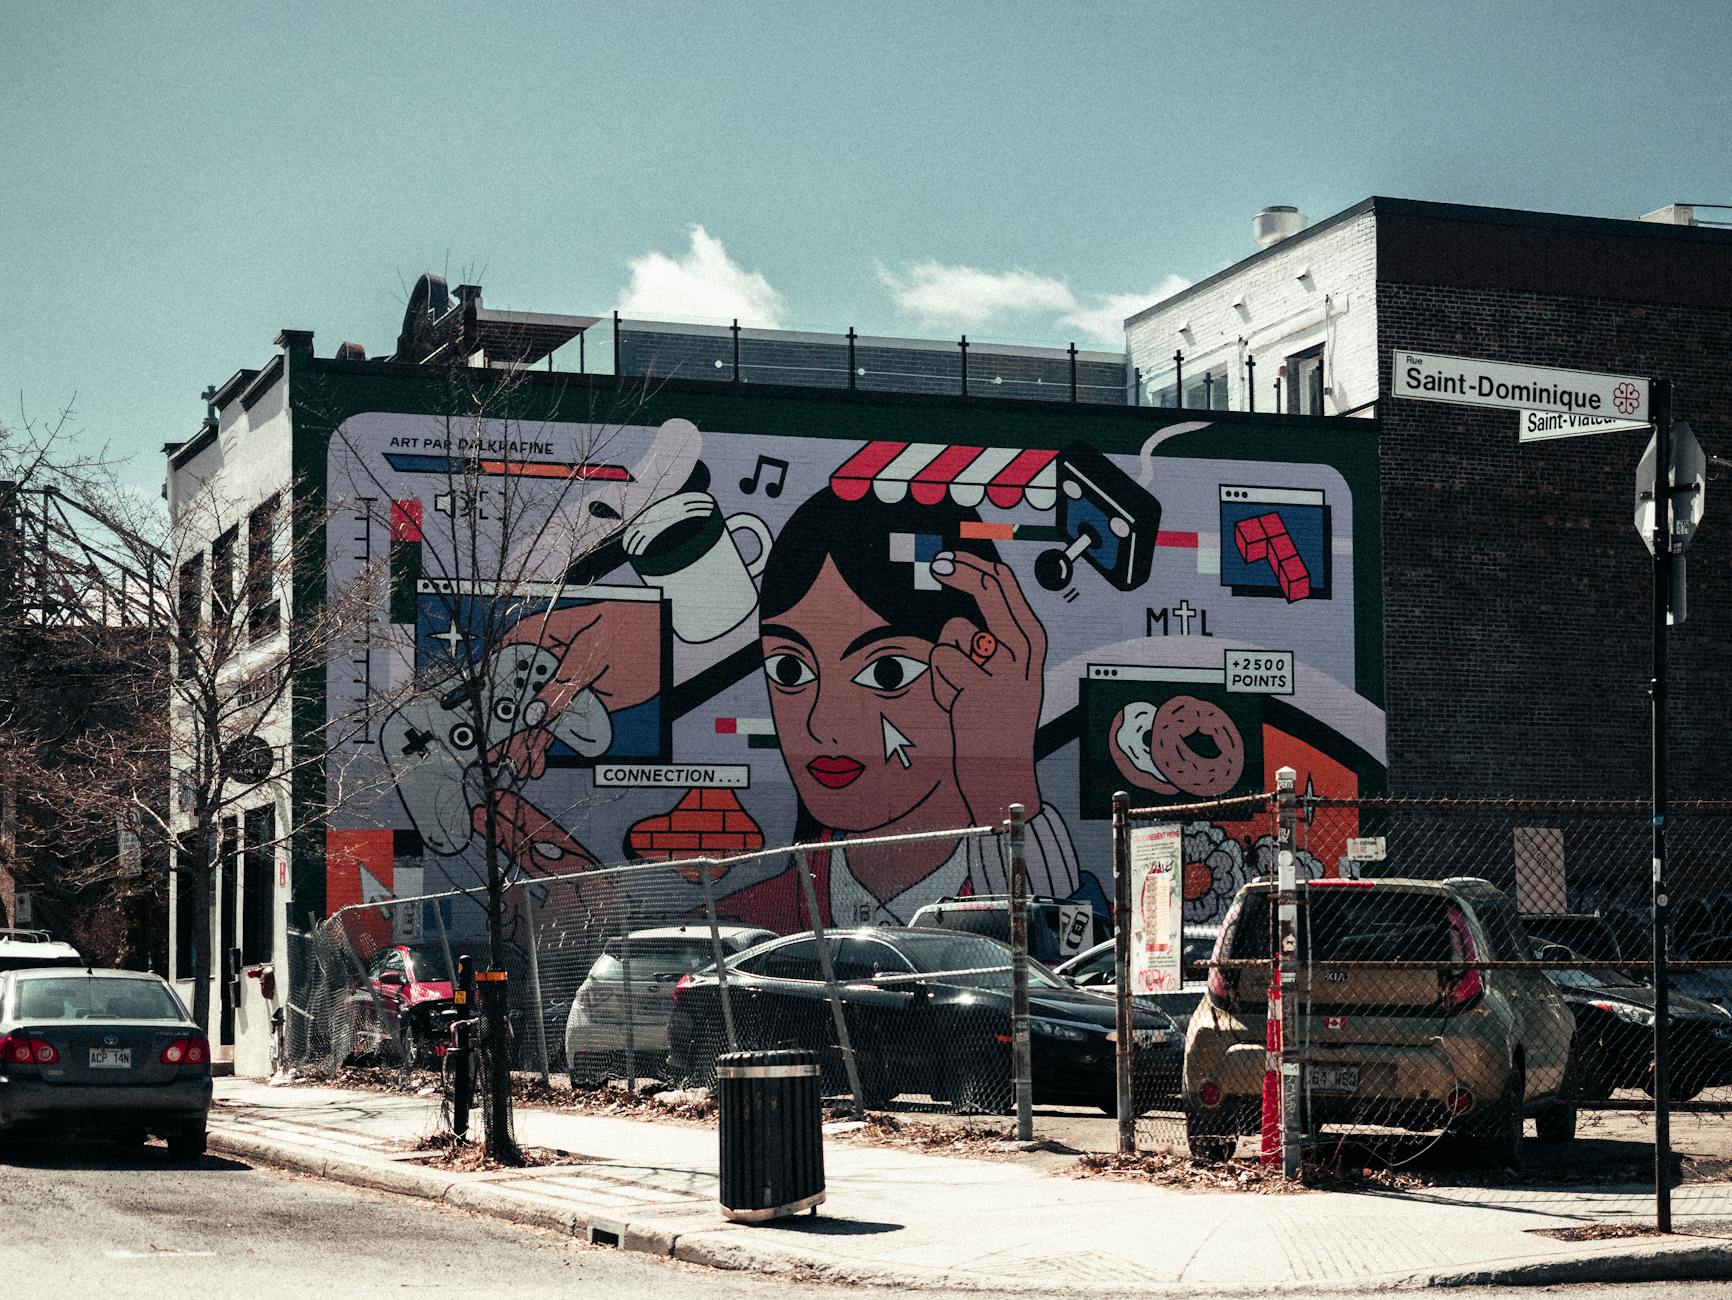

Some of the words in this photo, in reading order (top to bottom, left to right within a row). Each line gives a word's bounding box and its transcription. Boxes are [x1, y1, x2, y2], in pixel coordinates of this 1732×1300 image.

[1406, 355, 1423, 366] Rue
[1406, 367, 1602, 411] Saint-Dominique
[390, 437, 419, 448] ART
[423, 438, 452, 450] PAR
[1231, 657, 1286, 672] +2500
[1232, 673, 1287, 689] POINTS
[90, 1052, 108, 1064] ACP
[114, 1052, 130, 1064] 14N
